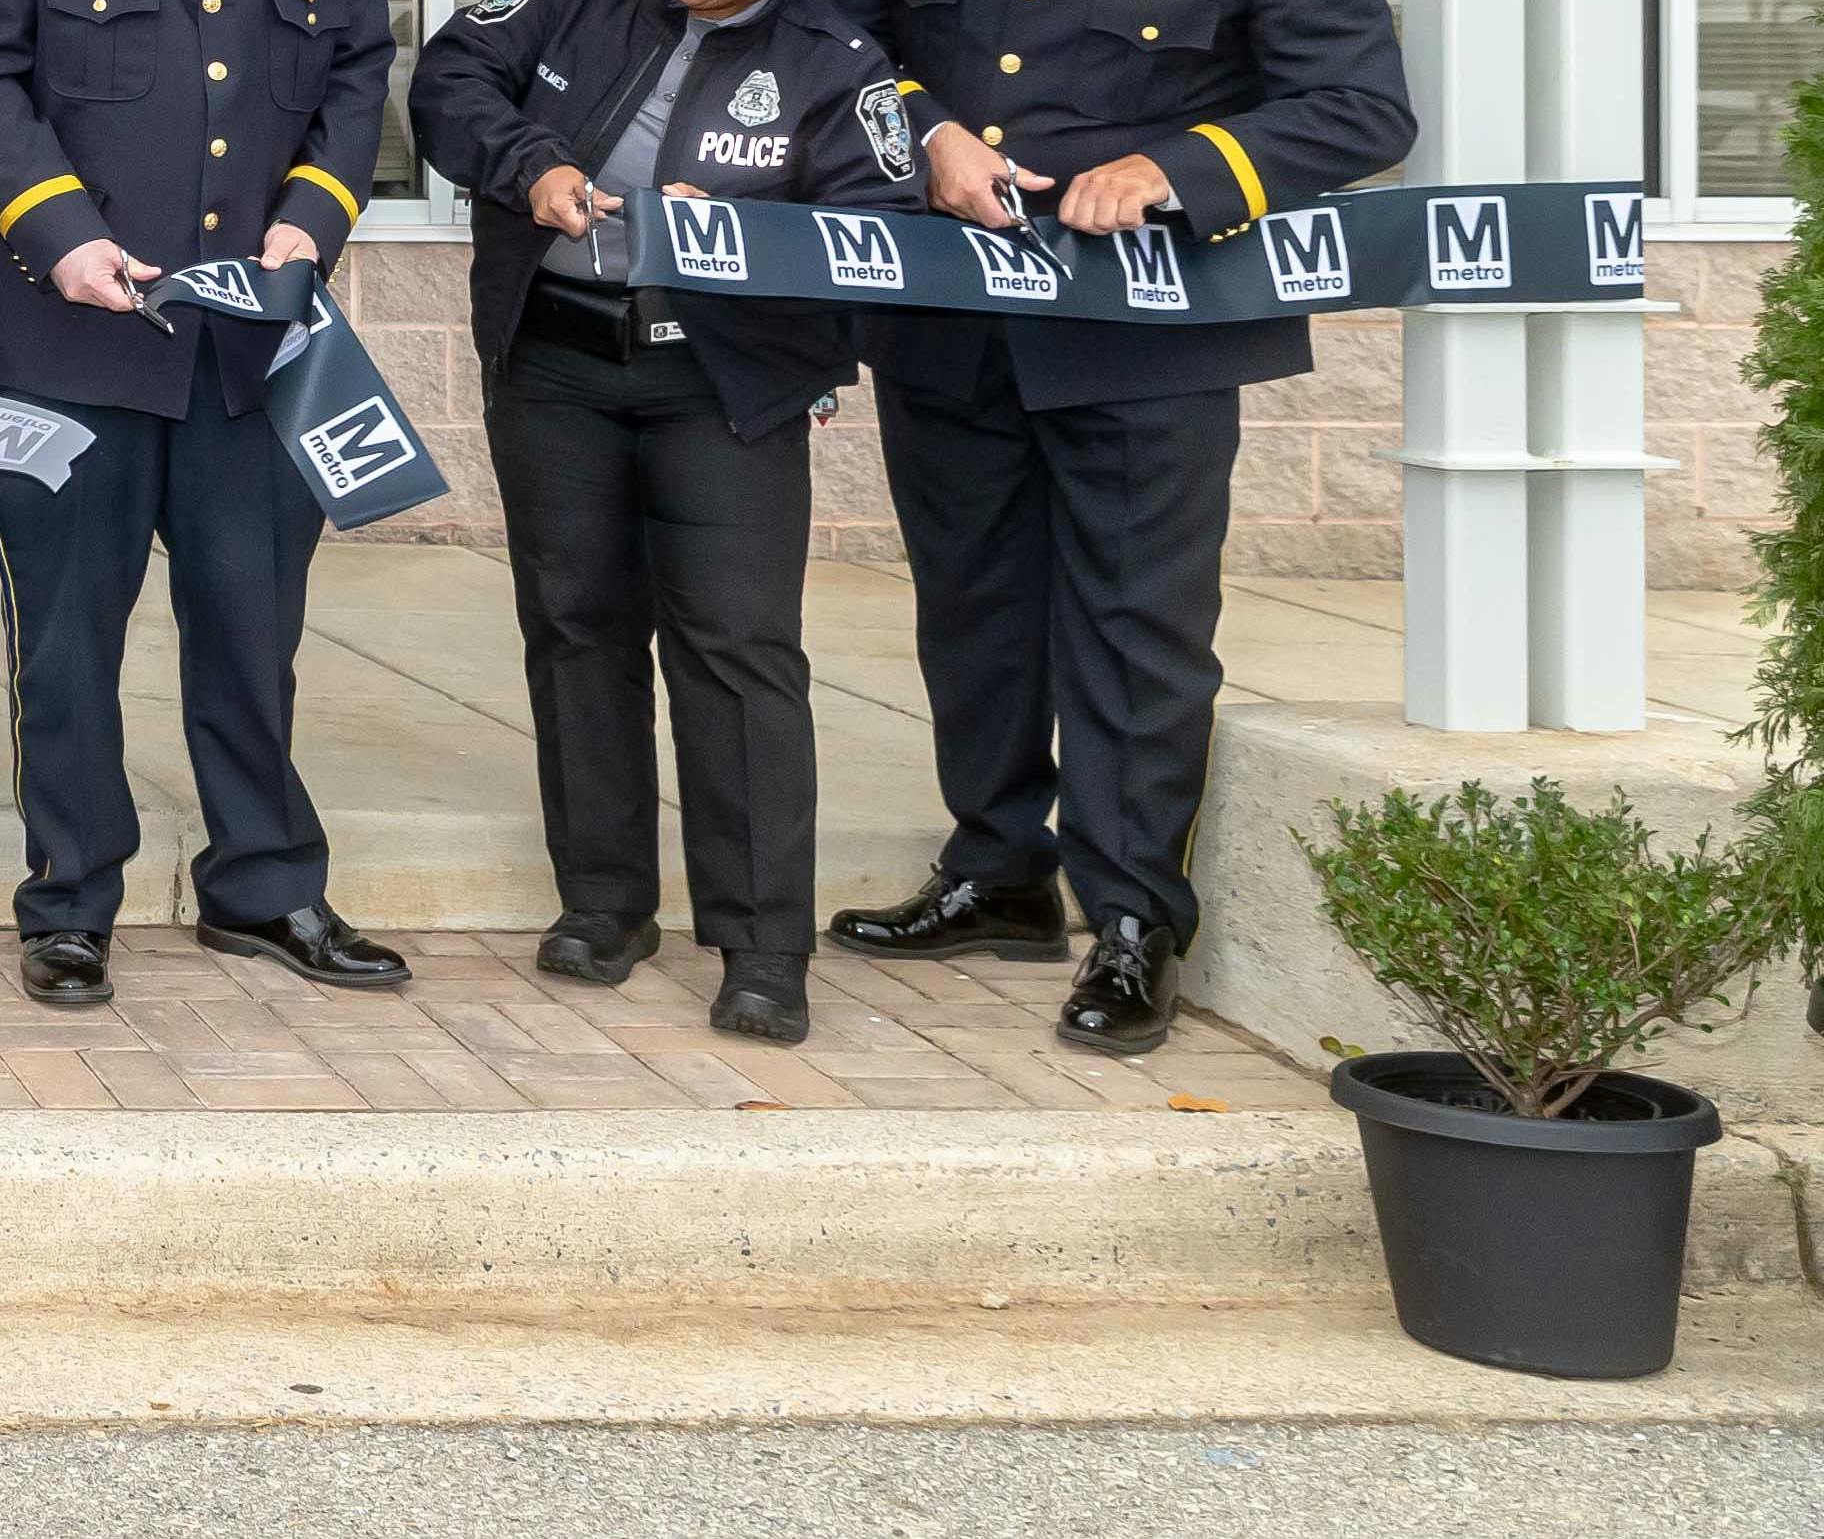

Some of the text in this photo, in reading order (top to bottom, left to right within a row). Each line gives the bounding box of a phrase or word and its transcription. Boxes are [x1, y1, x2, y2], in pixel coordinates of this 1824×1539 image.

[697, 131, 790, 168] POLICE
[670, 200, 738, 256] M
[822, 216, 895, 265] M
[1266, 212, 1342, 277] M
[1436, 203, 1502, 263] M
[1592, 199, 1643, 260] M
[179, 262, 249, 297] M
[682, 255, 740, 274] metro
[836, 263, 897, 282] metro
[1437, 264, 1505, 281] metro
[198, 285, 254, 308] metro
[991, 275, 1051, 294] metro
[1131, 287, 1180, 304] metro
[1282, 274, 1344, 294] metro
[326, 403, 407, 481] M
[309, 433, 350, 490] metro
